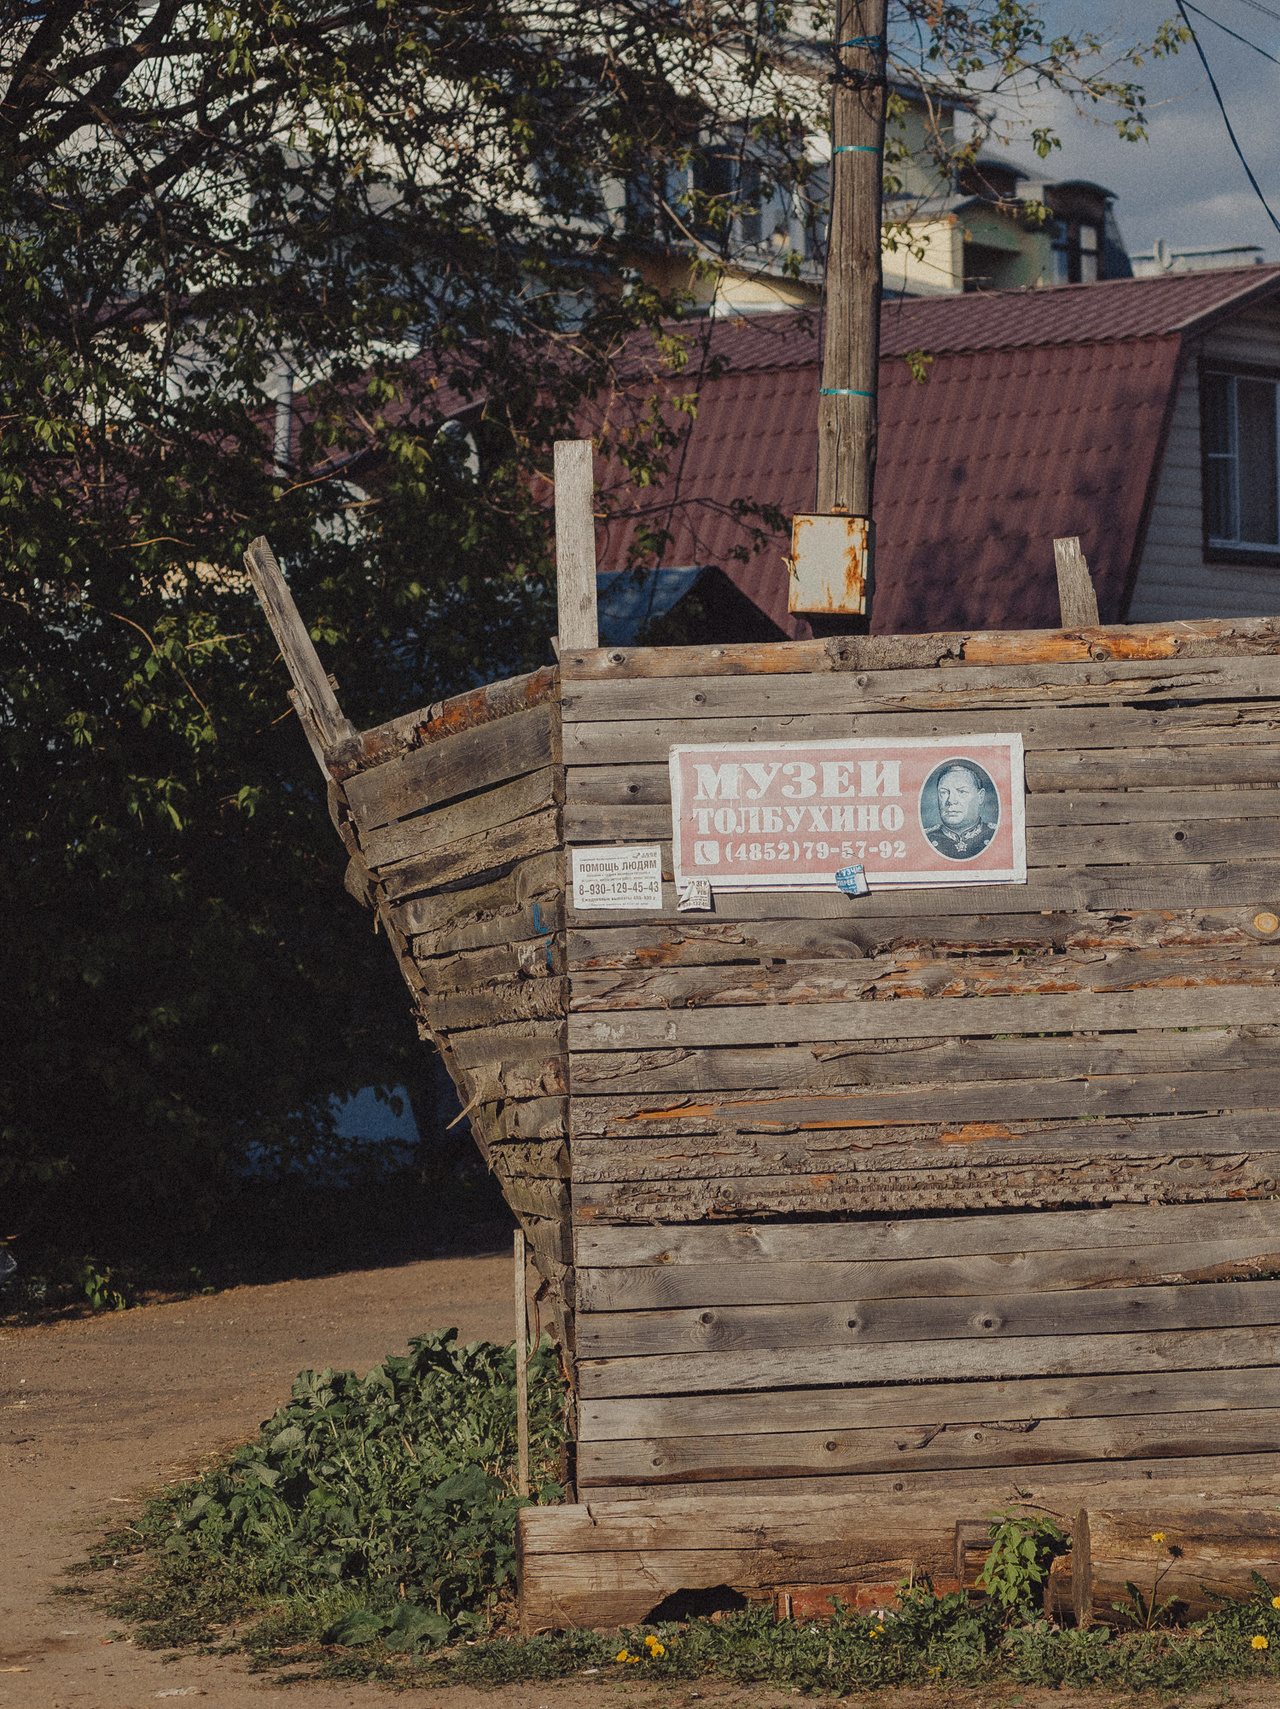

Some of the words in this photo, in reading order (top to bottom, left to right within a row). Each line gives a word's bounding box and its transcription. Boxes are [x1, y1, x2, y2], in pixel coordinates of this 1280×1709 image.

[692, 803, 905, 835] ТОЛБУХИНО
[579, 862, 620, 873] ПОМОЩЬ
[622, 859, 657, 871] ЛЮДЯМ
[578, 880, 659, 896] 8-930-129-45-43
